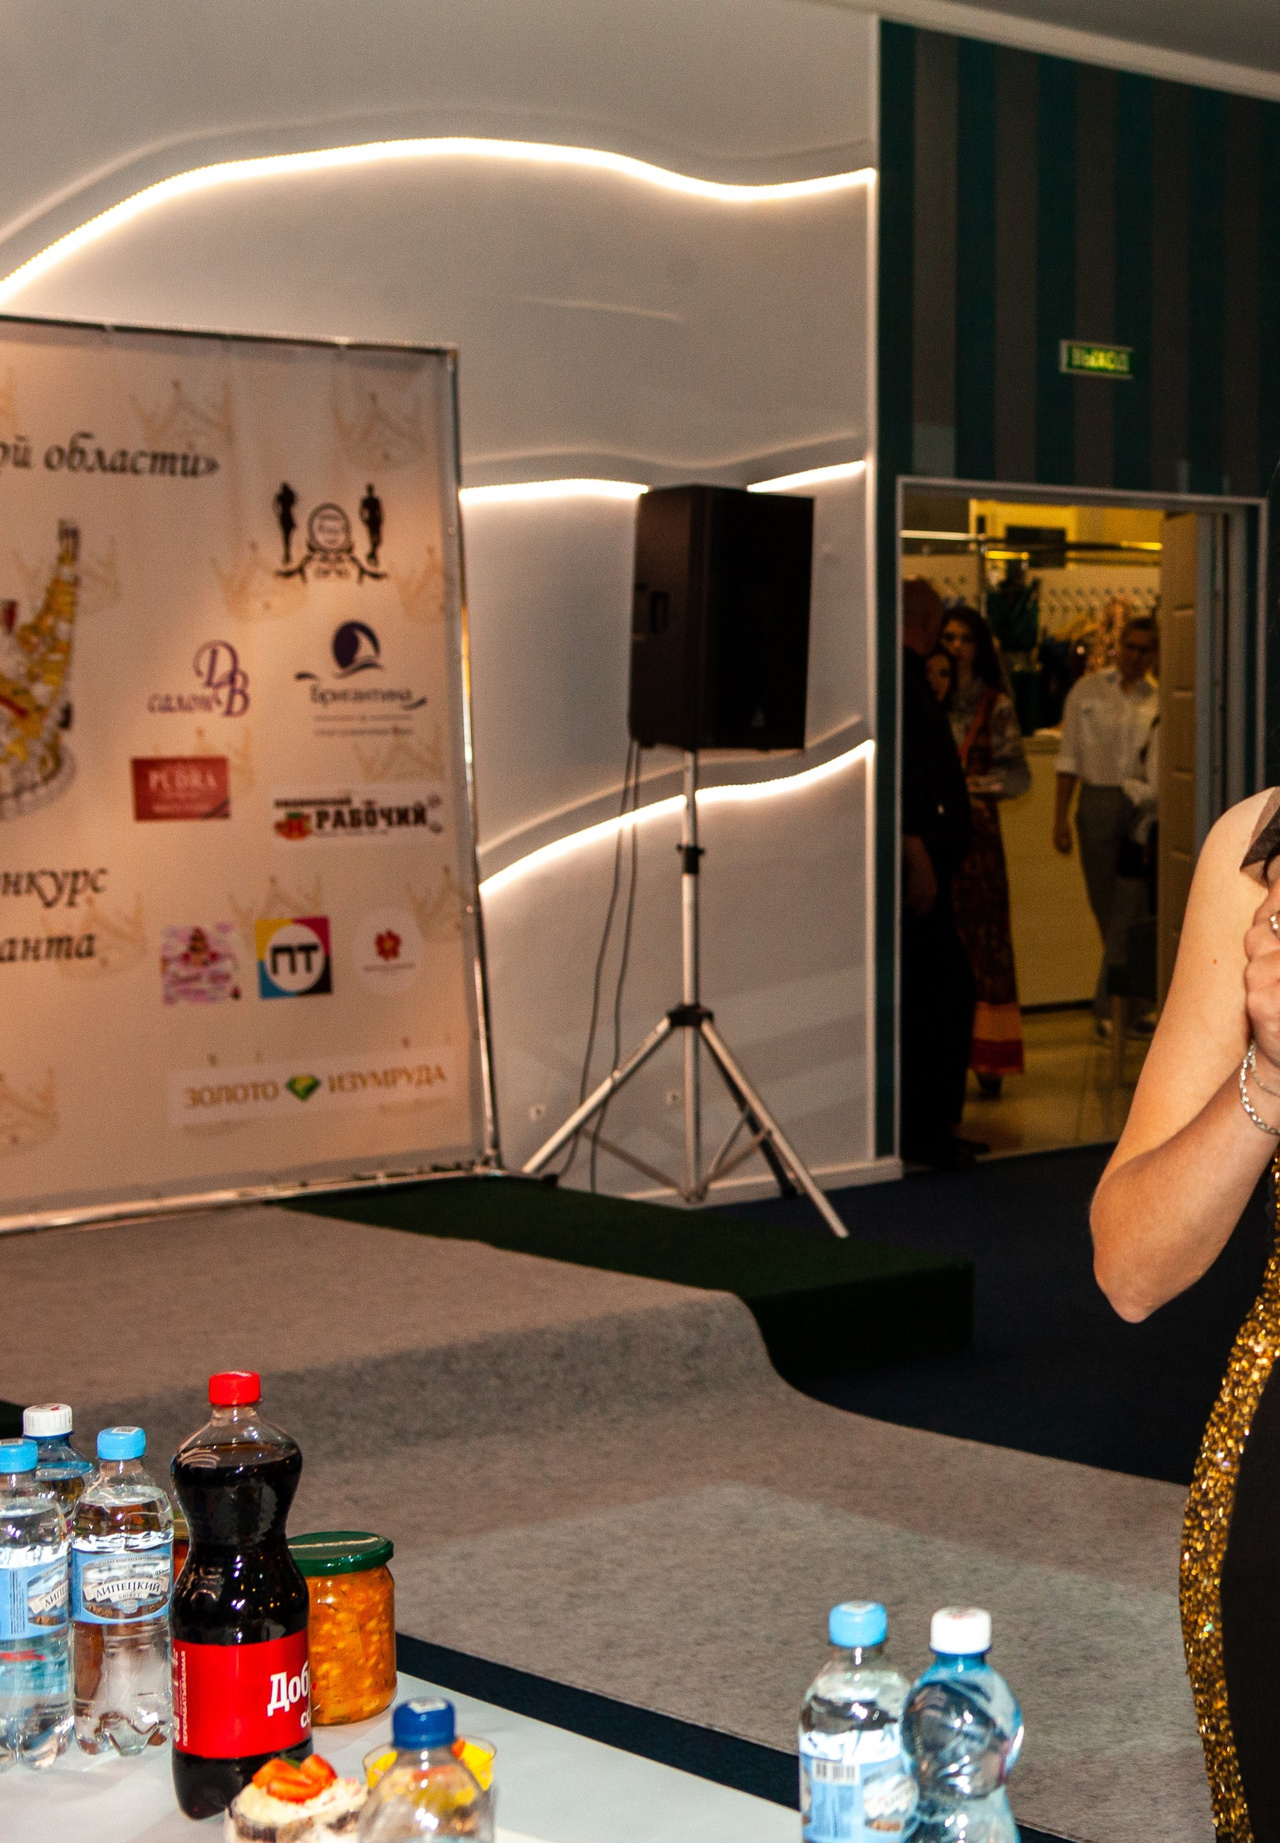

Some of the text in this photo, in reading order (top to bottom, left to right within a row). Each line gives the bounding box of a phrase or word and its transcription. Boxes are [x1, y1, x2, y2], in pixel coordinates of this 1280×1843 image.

[44, 431, 220, 478] области»
[315, 800, 428, 831] РАБОЧИЙ
[0, 867, 107, 909] нкурс
[0, 933, 96, 962] анта
[270, 943, 320, 976] ПТ
[184, 1063, 448, 1109] ЗОЛОТО ИЗУМРУДА
[96, 1580, 161, 1600] ЛИПЕЦКИЙ
